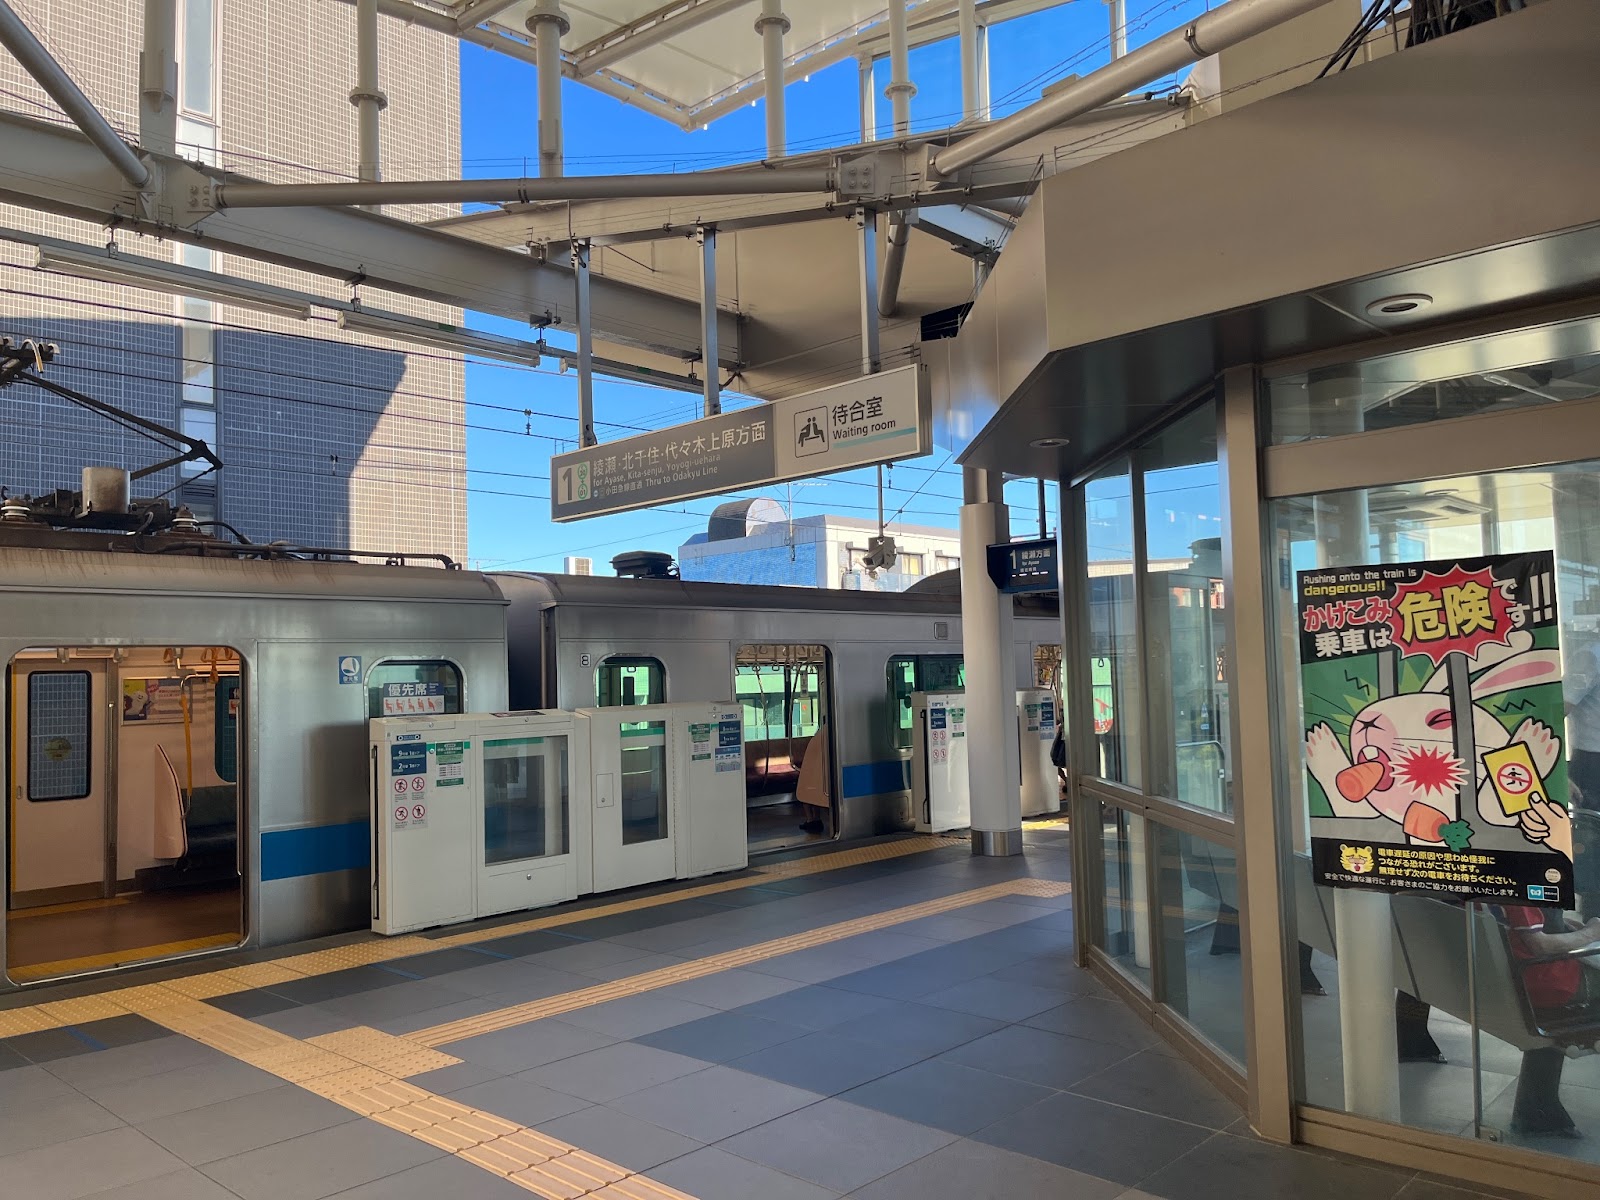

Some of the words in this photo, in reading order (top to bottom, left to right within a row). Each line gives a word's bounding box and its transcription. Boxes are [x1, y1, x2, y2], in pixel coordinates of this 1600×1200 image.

[832, 396, 883, 427] 待合室
[832, 425, 868, 440] Waiting
[871, 420, 896, 432] room
[593, 480, 602, 488] for
[604, 474, 626, 486] Ayase,
[627, 466, 664, 480] Kita-senju,
[666, 454, 721, 471] Yoyogi-uehara
[646, 476, 661, 487] Thru
[663, 475, 671, 484] to
[672, 468, 701, 483] Odakyu
[702, 465, 718, 476] Line
[562, 467, 573, 501] 1
[1010, 550, 1017, 570] 1
[1303, 574, 1336, 585] Rushing
[1340, 572, 1361, 582] onto
[1364, 570, 1380, 580] the
[1383, 569, 1405, 579] train
[1303, 580, 1386, 596] dangerous!!
[1302, 596, 1393, 632] かけこみ
[1397, 580, 1497, 645] 危険
[1315, 628, 1392, 658] 乗車は
[581, 655, 589, 666] 8
[388, 683, 428, 697] 優先席
[1377, 847, 1496, 865] 電車遅延の原因や思わぬ怪我に
[1379, 857, 1480, 873] つながる恐れがございます。
[1378, 866, 1517, 886] 無理せず次の電車をお待ちください。
